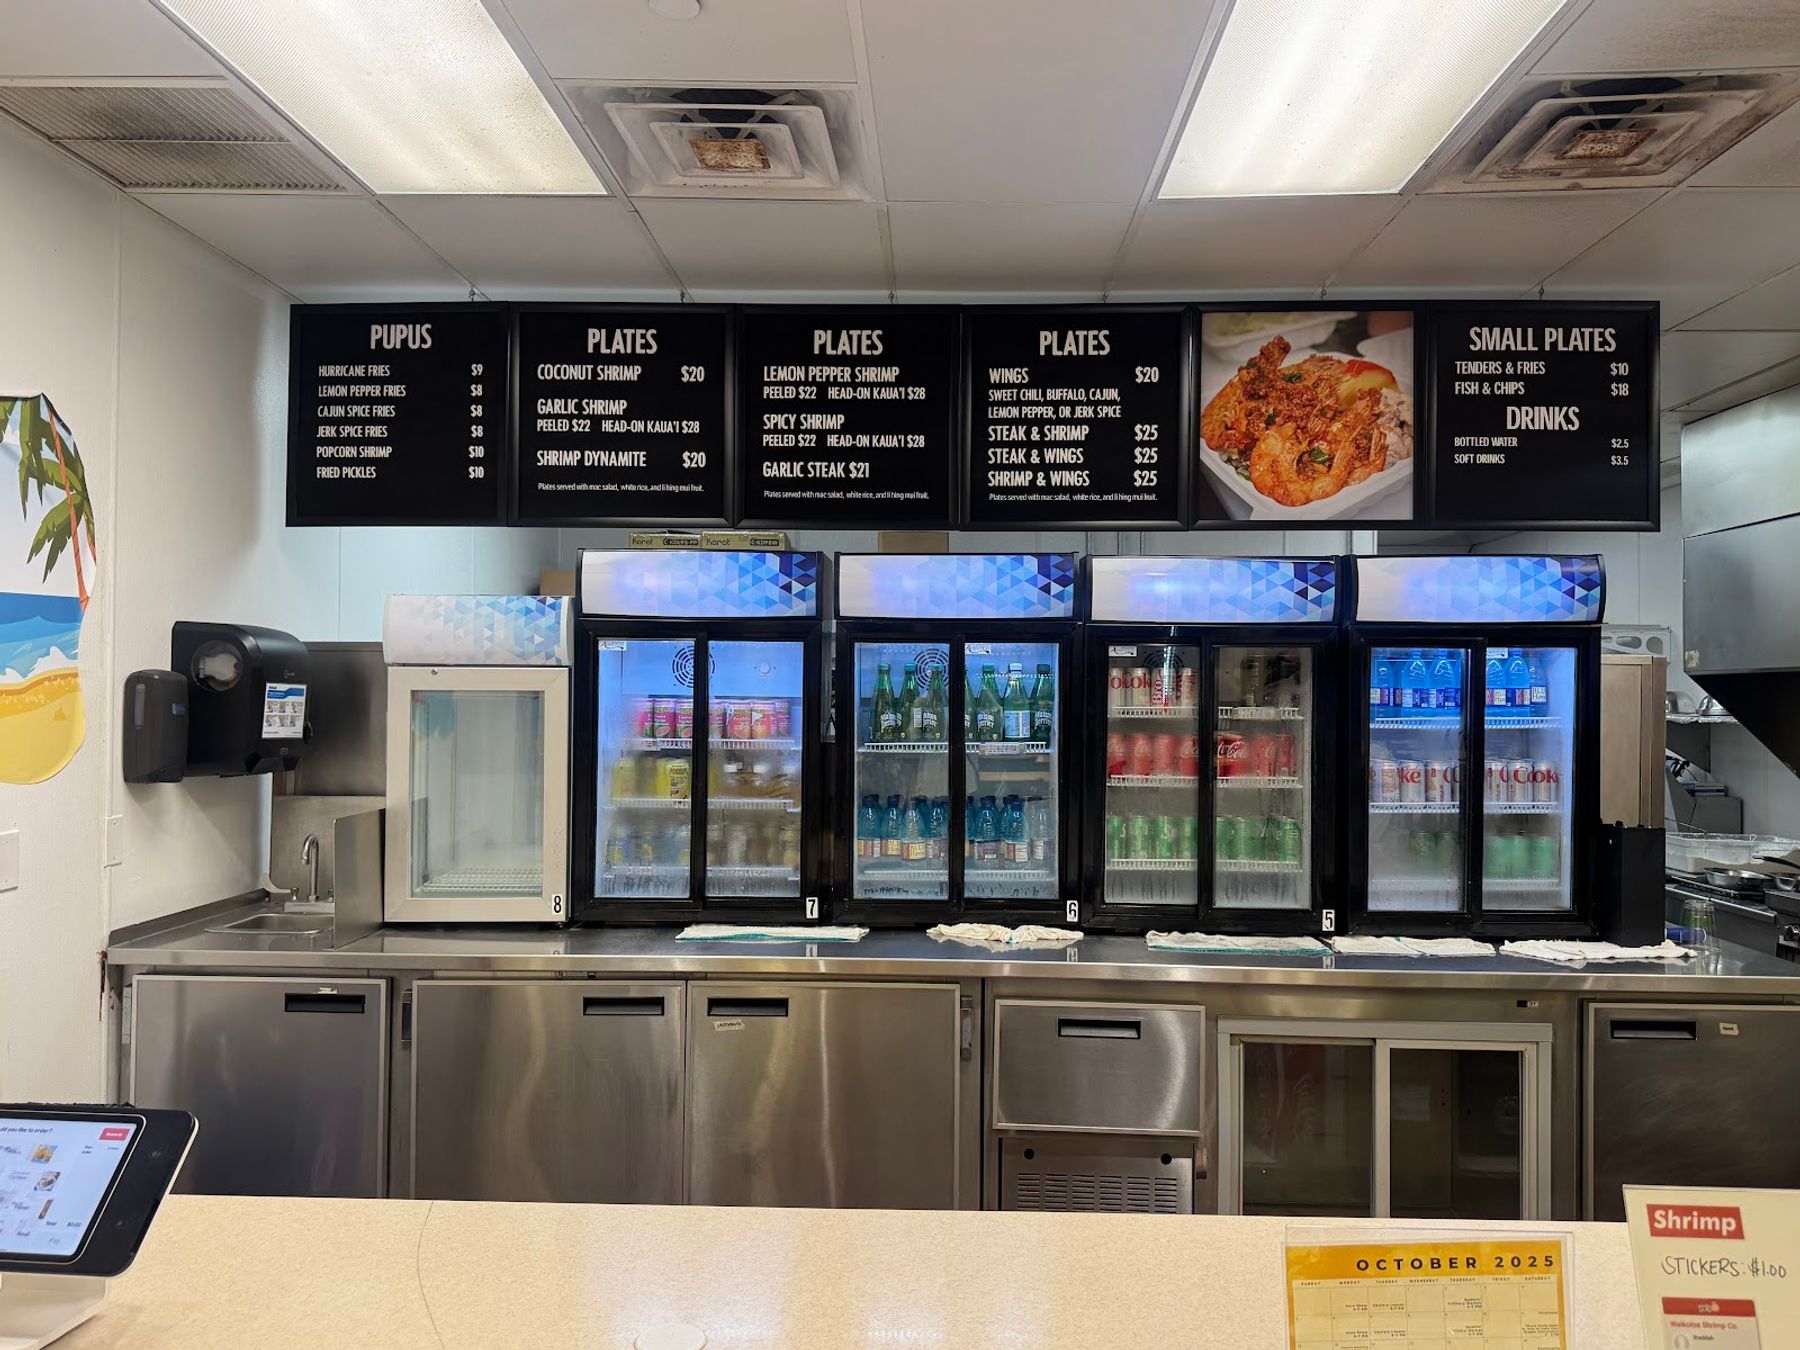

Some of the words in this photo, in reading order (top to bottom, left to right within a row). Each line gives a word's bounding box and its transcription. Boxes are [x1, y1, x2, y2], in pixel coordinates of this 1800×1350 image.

[371, 324, 432, 349] PUPUS
[588, 328, 657, 354] PLATES
[814, 330, 883, 355] PLATES
[1040, 330, 1110, 356] PLATES
[1470, 327, 1538, 350] SMALL
[1545, 328, 1616, 352] PLATES
[319, 365, 366, 376] HURRICANE
[368, 365, 390, 376] FRIES
[472, 364, 483, 376] $9
[538, 364, 593, 380] COCONUT
[597, 365, 641, 380] SHRIMP
[681, 365, 704, 382] $20
[764, 366, 805, 381] LEMON
[808, 366, 851, 382] PEPPER
[855, 367, 899, 382] SHRIMP
[989, 368, 1028, 383] WINGS
[1136, 366, 1159, 383] $20
[1455, 361, 1502, 374] TENDERS
[1506, 362, 1514, 374] &
[1517, 362, 1545, 374] FRIES
[1610, 362, 1628, 376] $10
[319, 385, 347, 397] LEMON
[350, 385, 381, 396] PEPPER
[384, 385, 406, 396] FRIES
[471, 384, 482, 396] $8
[764, 386, 796, 398] PEELED
[798, 386, 816, 399] $22
[828, 387, 870, 399] HEAD-ON
[908, 387, 925, 400] $28
[989, 389, 1018, 401] SWEET
[1020, 389, 1044, 402] CHILI,
[1047, 388, 1087, 402] BUFFALO,
[1090, 388, 1120, 402] CAJUN,
[1455, 382, 1478, 394] FISH
[1482, 382, 1491, 394] &
[1494, 382, 1524, 394] CHIPS
[1611, 382, 1628, 396] $18
[318, 406, 345, 417] CAJUN
[347, 405, 370, 417] SPICE
[373, 406, 395, 417] FRIES
[471, 404, 482, 417] $8
[537, 399, 578, 414] GARLIC
[582, 399, 627, 415] SHRIMP
[988, 406, 1019, 418] LEMON
[1022, 406, 1056, 420] PEPPER,
[1059, 406, 1071, 418] OR
[1074, 406, 1094, 418] JERK
[1097, 406, 1121, 418] SPICE
[763, 414, 796, 429] SPICY
[800, 414, 844, 429] SHRIMP
[1507, 406, 1579, 430] DRINKS
[316, 426, 337, 437] JERK
[340, 426, 363, 437] SPICE
[365, 426, 388, 437] FRIES
[471, 425, 483, 438] $8
[537, 419, 569, 431] PEELED
[572, 419, 590, 432] $22
[602, 420, 644, 432] HEAD-ON
[682, 420, 699, 434] $28
[988, 426, 1026, 441] STEAK
[1031, 426, 1040, 440] &
[1044, 425, 1089, 440] SHRIMP
[1134, 424, 1158, 441] $25
[763, 435, 795, 446] PEELED
[798, 434, 816, 447] $22
[827, 434, 869, 447] HEAD-ON
[907, 435, 924, 448] $28
[1455, 437, 1489, 446] BOTTLED
[1491, 437, 1517, 446] WATER
[1612, 438, 1628, 448] $2.5
[317, 446, 357, 457] POPCORN
[359, 446, 392, 457] SHRIMP
[469, 446, 484, 458] $10
[537, 450, 581, 466] SHRIMP
[584, 451, 646, 466] DYNAMITE
[682, 451, 706, 468] $20
[988, 448, 1026, 464] STEAK
[1030, 449, 1040, 464] &
[1044, 448, 1084, 463] WINGS
[1134, 447, 1158, 464] $25
[1454, 454, 1474, 464] SOFT
[1476, 454, 1505, 464] DRINKS
[1611, 456, 1628, 465] $3.5
[317, 467, 340, 478] FRIED
[342, 466, 376, 478] PICKLES
[469, 466, 484, 478] $10
[763, 462, 804, 477] GARLIC
[808, 462, 845, 478] STEAK
[849, 462, 869, 478] $21
[988, 471, 1033, 486] SHRIMP
[1036, 472, 1046, 486] &
[1050, 471, 1090, 486] WINGS
[1134, 470, 1157, 487] $25
[538, 482, 556, 490] Plates
[556, 482, 576, 490] served
[576, 482, 588, 490] with
[588, 484, 601, 492] mac
[620, 483, 636, 491] white
[649, 483, 661, 491] and
[764, 489, 781, 498] Plates
[782, 490, 801, 498] served
[802, 490, 814, 498] with
[815, 491, 827, 499] mac
[846, 490, 861, 498] white
[874, 491, 886, 499] and
[989, 492, 1007, 500] Plates
[1008, 493, 1027, 501] served
[1028, 493, 1040, 501] with
[1041, 494, 1053, 502] mac
[1072, 493, 1088, 501] white
[1102, 493, 1113, 501] and
[554, 896, 562, 913] 8
[808, 899, 816, 916] 7
[1069, 902, 1077, 919] 6
[1325, 911, 1333, 929] 5
[1654, 1209, 1736, 1236] Shrimp
[1356, 1256, 1478, 1271] OCTOBER
[1494, 1255, 1554, 1268] 2025
[1661, 1256, 1746, 1277] STICKERS:
[1748, 1257, 1787, 1278] $1.00
[1702, 1321, 1726, 1330] Shrimp
